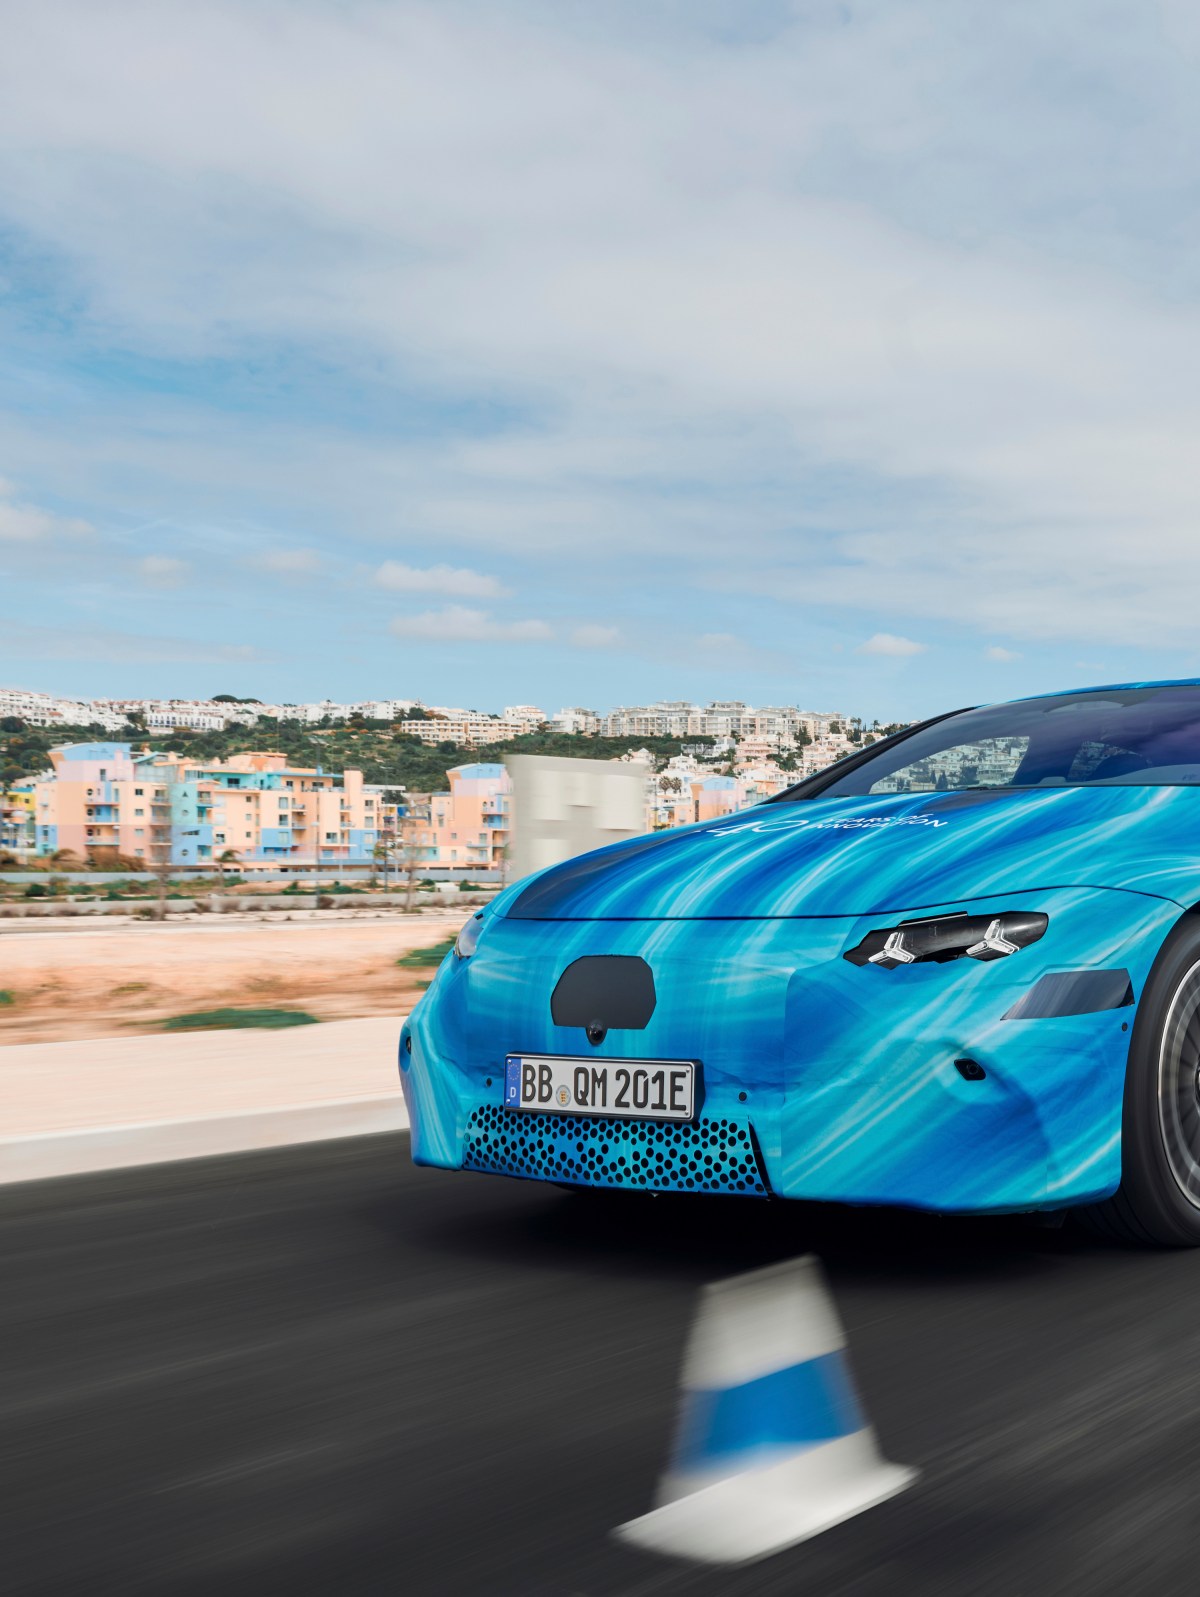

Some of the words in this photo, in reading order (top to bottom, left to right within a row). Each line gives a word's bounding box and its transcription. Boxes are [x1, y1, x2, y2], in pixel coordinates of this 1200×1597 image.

[693, 821, 810, 837] 40
[510, 1087, 516, 1098] D
[522, 1064, 552, 1103] BB
[573, 1067, 608, 1107] QM
[614, 1069, 687, 1111] 201E
